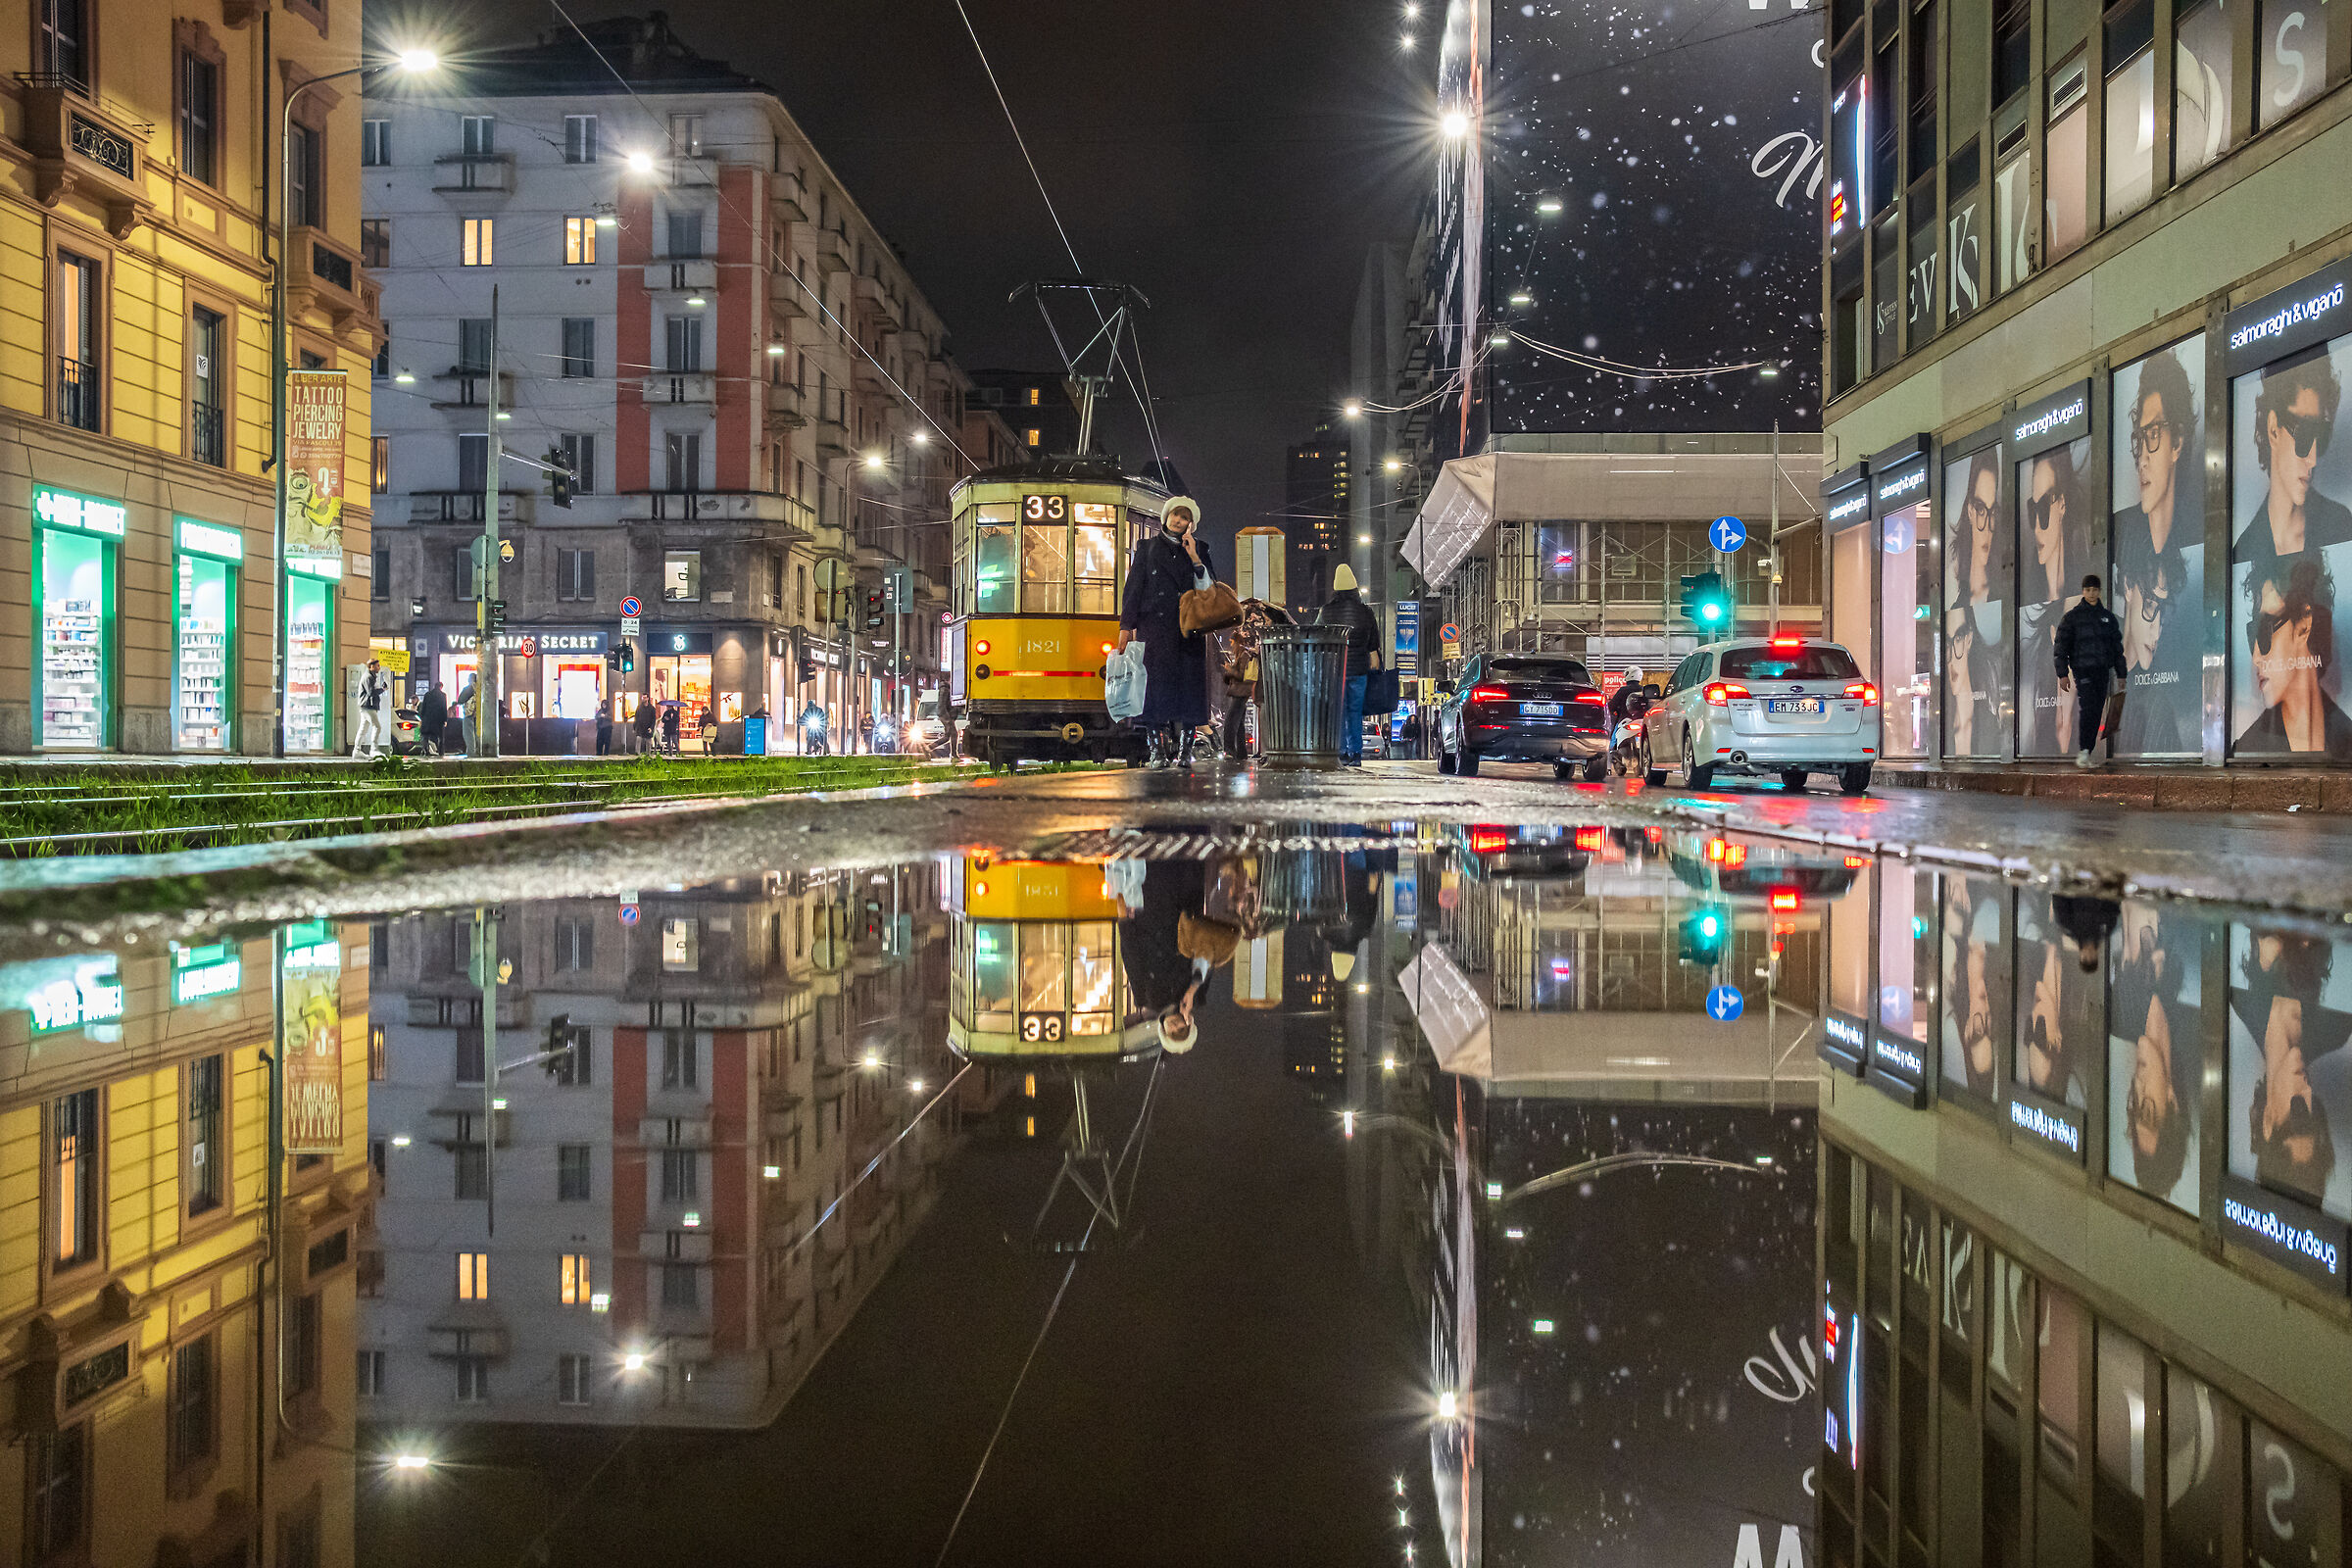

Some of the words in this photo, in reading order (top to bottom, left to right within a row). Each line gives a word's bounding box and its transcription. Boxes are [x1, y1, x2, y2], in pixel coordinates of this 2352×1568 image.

[295, 386, 343, 404] TATTOO
[294, 404, 342, 421] PIERCING
[293, 421, 341, 439] JEWELRY
[1026, 495, 1064, 519] 33
[524, 643, 533, 653] 30
[541, 635, 597, 649] SECRET
[1027, 640, 1059, 653] 1821
[1775, 703, 1787, 711] EM
